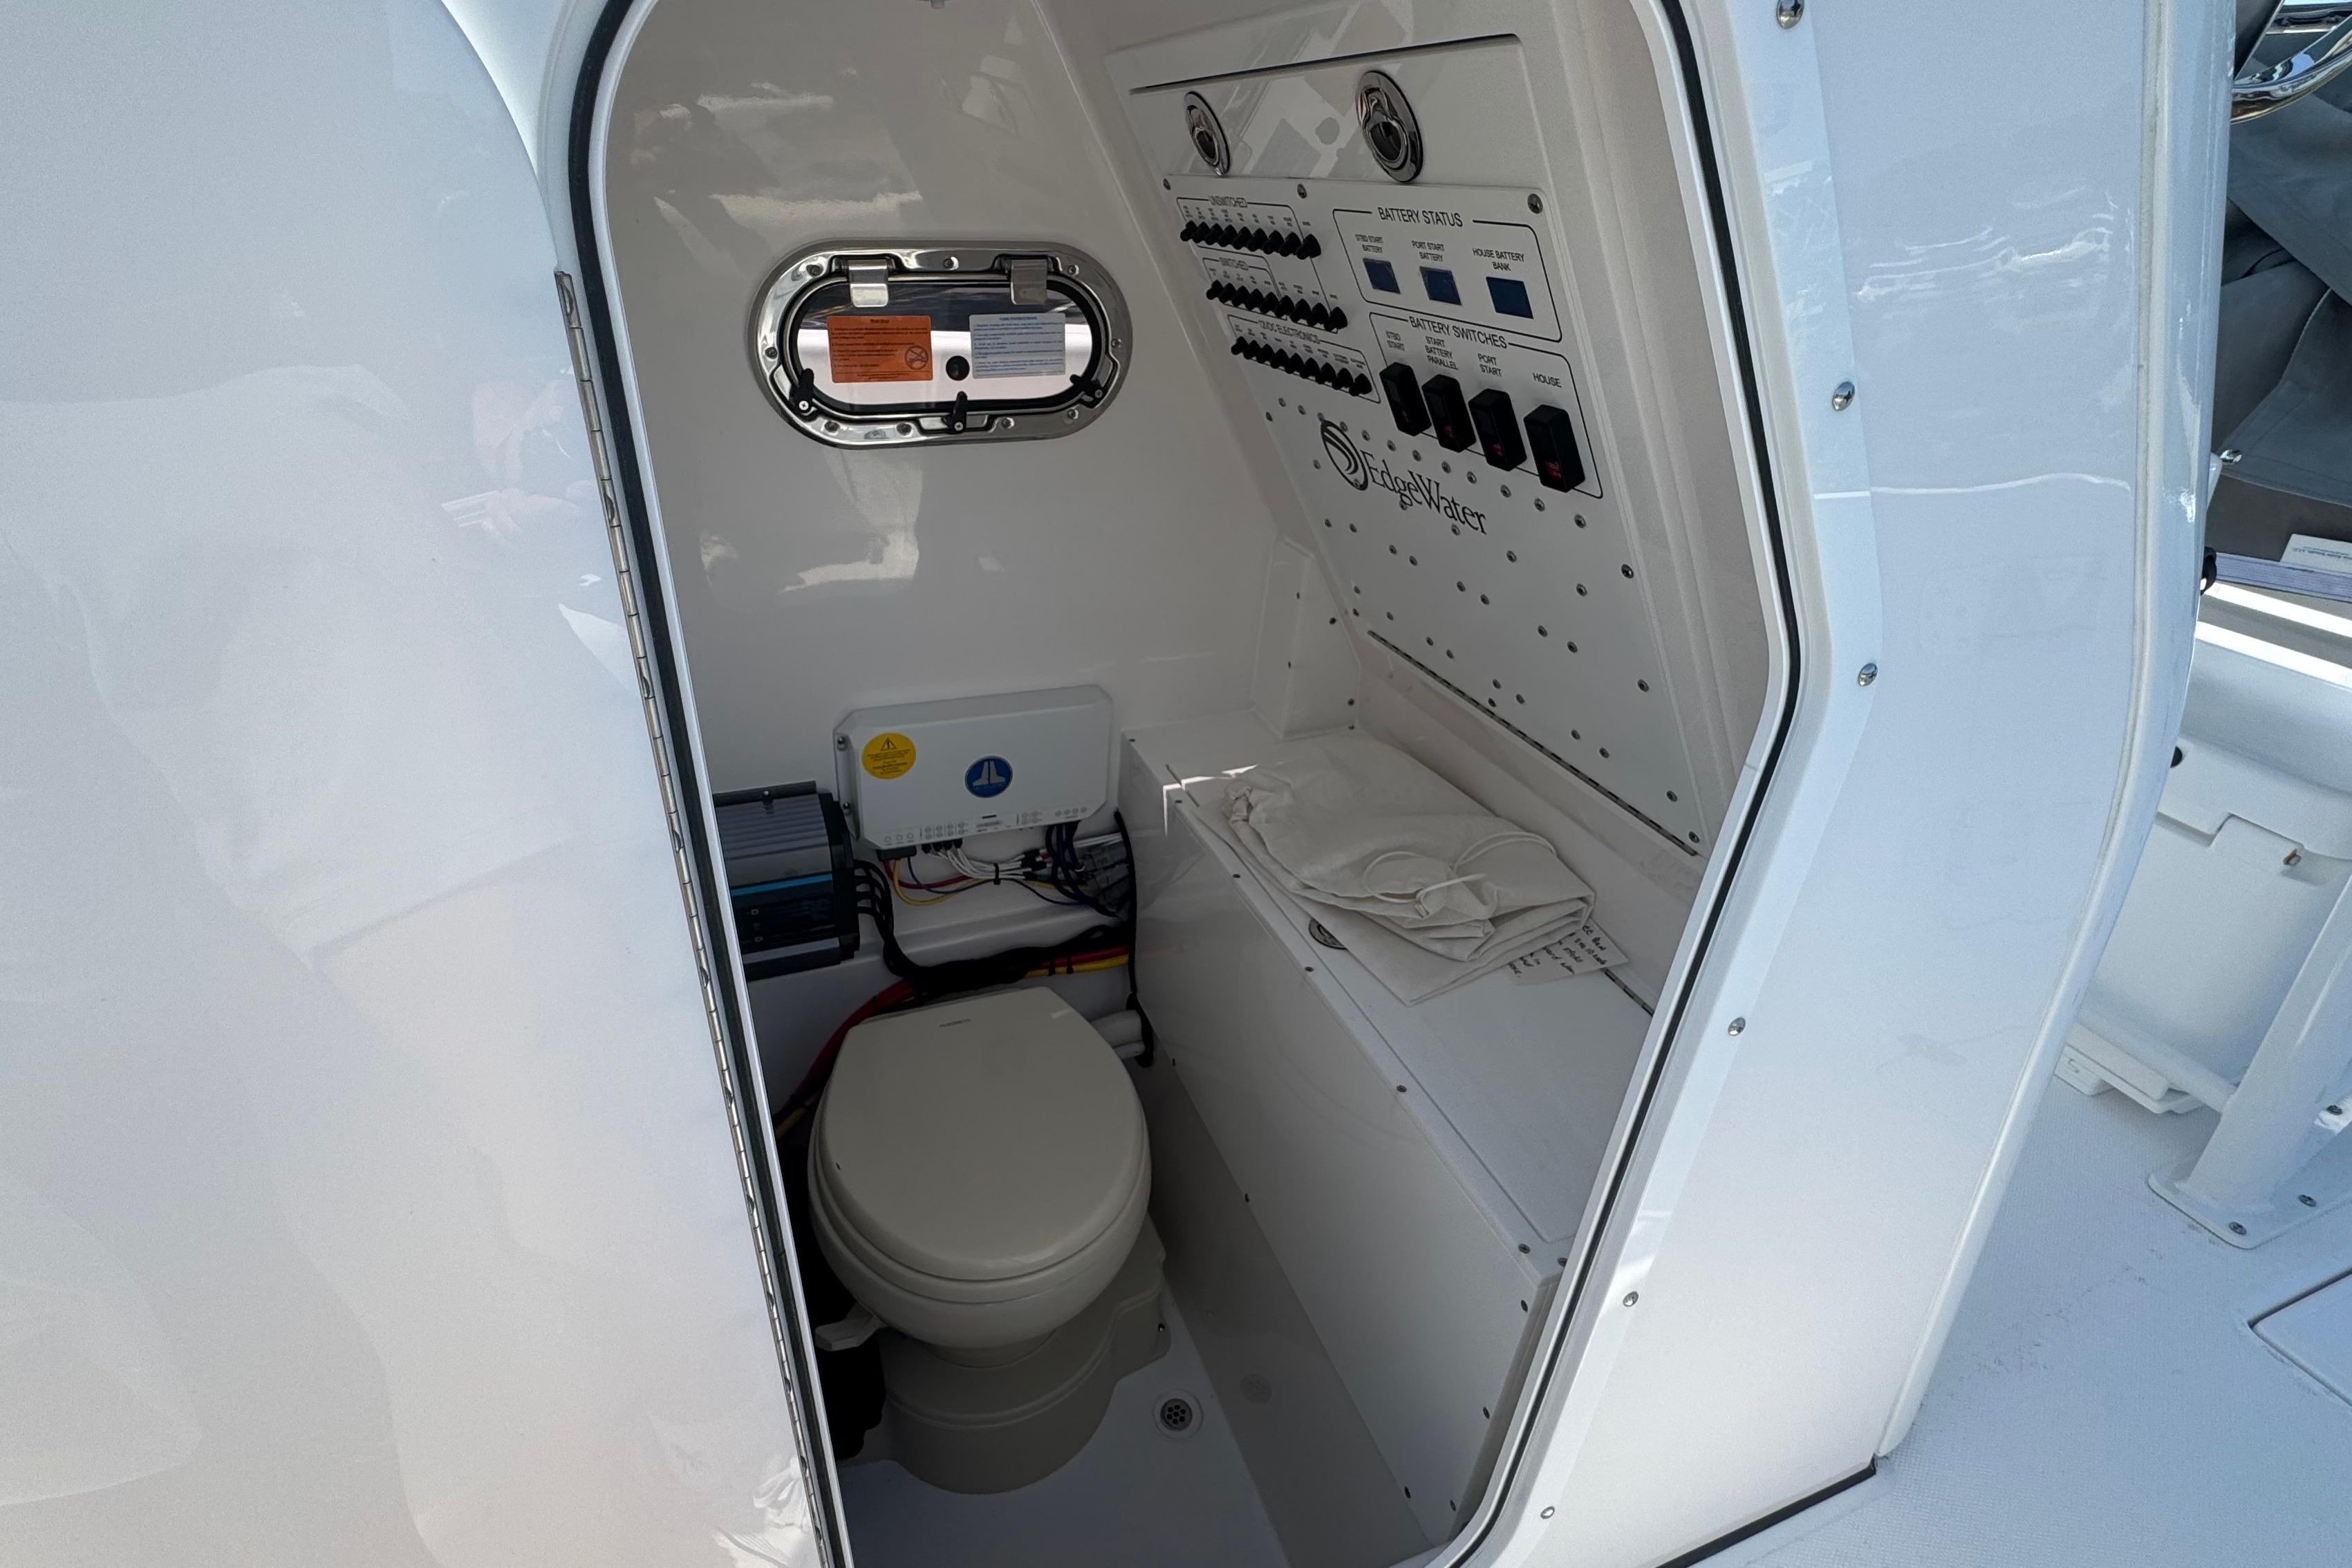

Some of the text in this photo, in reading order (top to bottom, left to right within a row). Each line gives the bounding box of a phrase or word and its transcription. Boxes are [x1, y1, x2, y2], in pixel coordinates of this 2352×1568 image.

[1378, 207, 1464, 227] BATTERY STATUS
[1362, 244, 1383, 254] BATTERY
[1412, 241, 1445, 252] PORT START
[1419, 252, 1444, 262] BATTERY
[1473, 248, 1524, 262] HOUSE BATTERY
[1493, 261, 1511, 272] BANK
[1409, 316, 1508, 349] BATTERY SWITCHES
[1387, 340, 1405, 351] START
[1426, 336, 1445, 347] START
[1425, 346, 1453, 360] BATTERY
[1477, 353, 1497, 366] PORT
[1427, 355, 1459, 371] PARALLEL
[1480, 364, 1502, 377] START
[1532, 373, 1562, 389] HOUSE
[1360, 449, 1487, 535] EdgeWater
